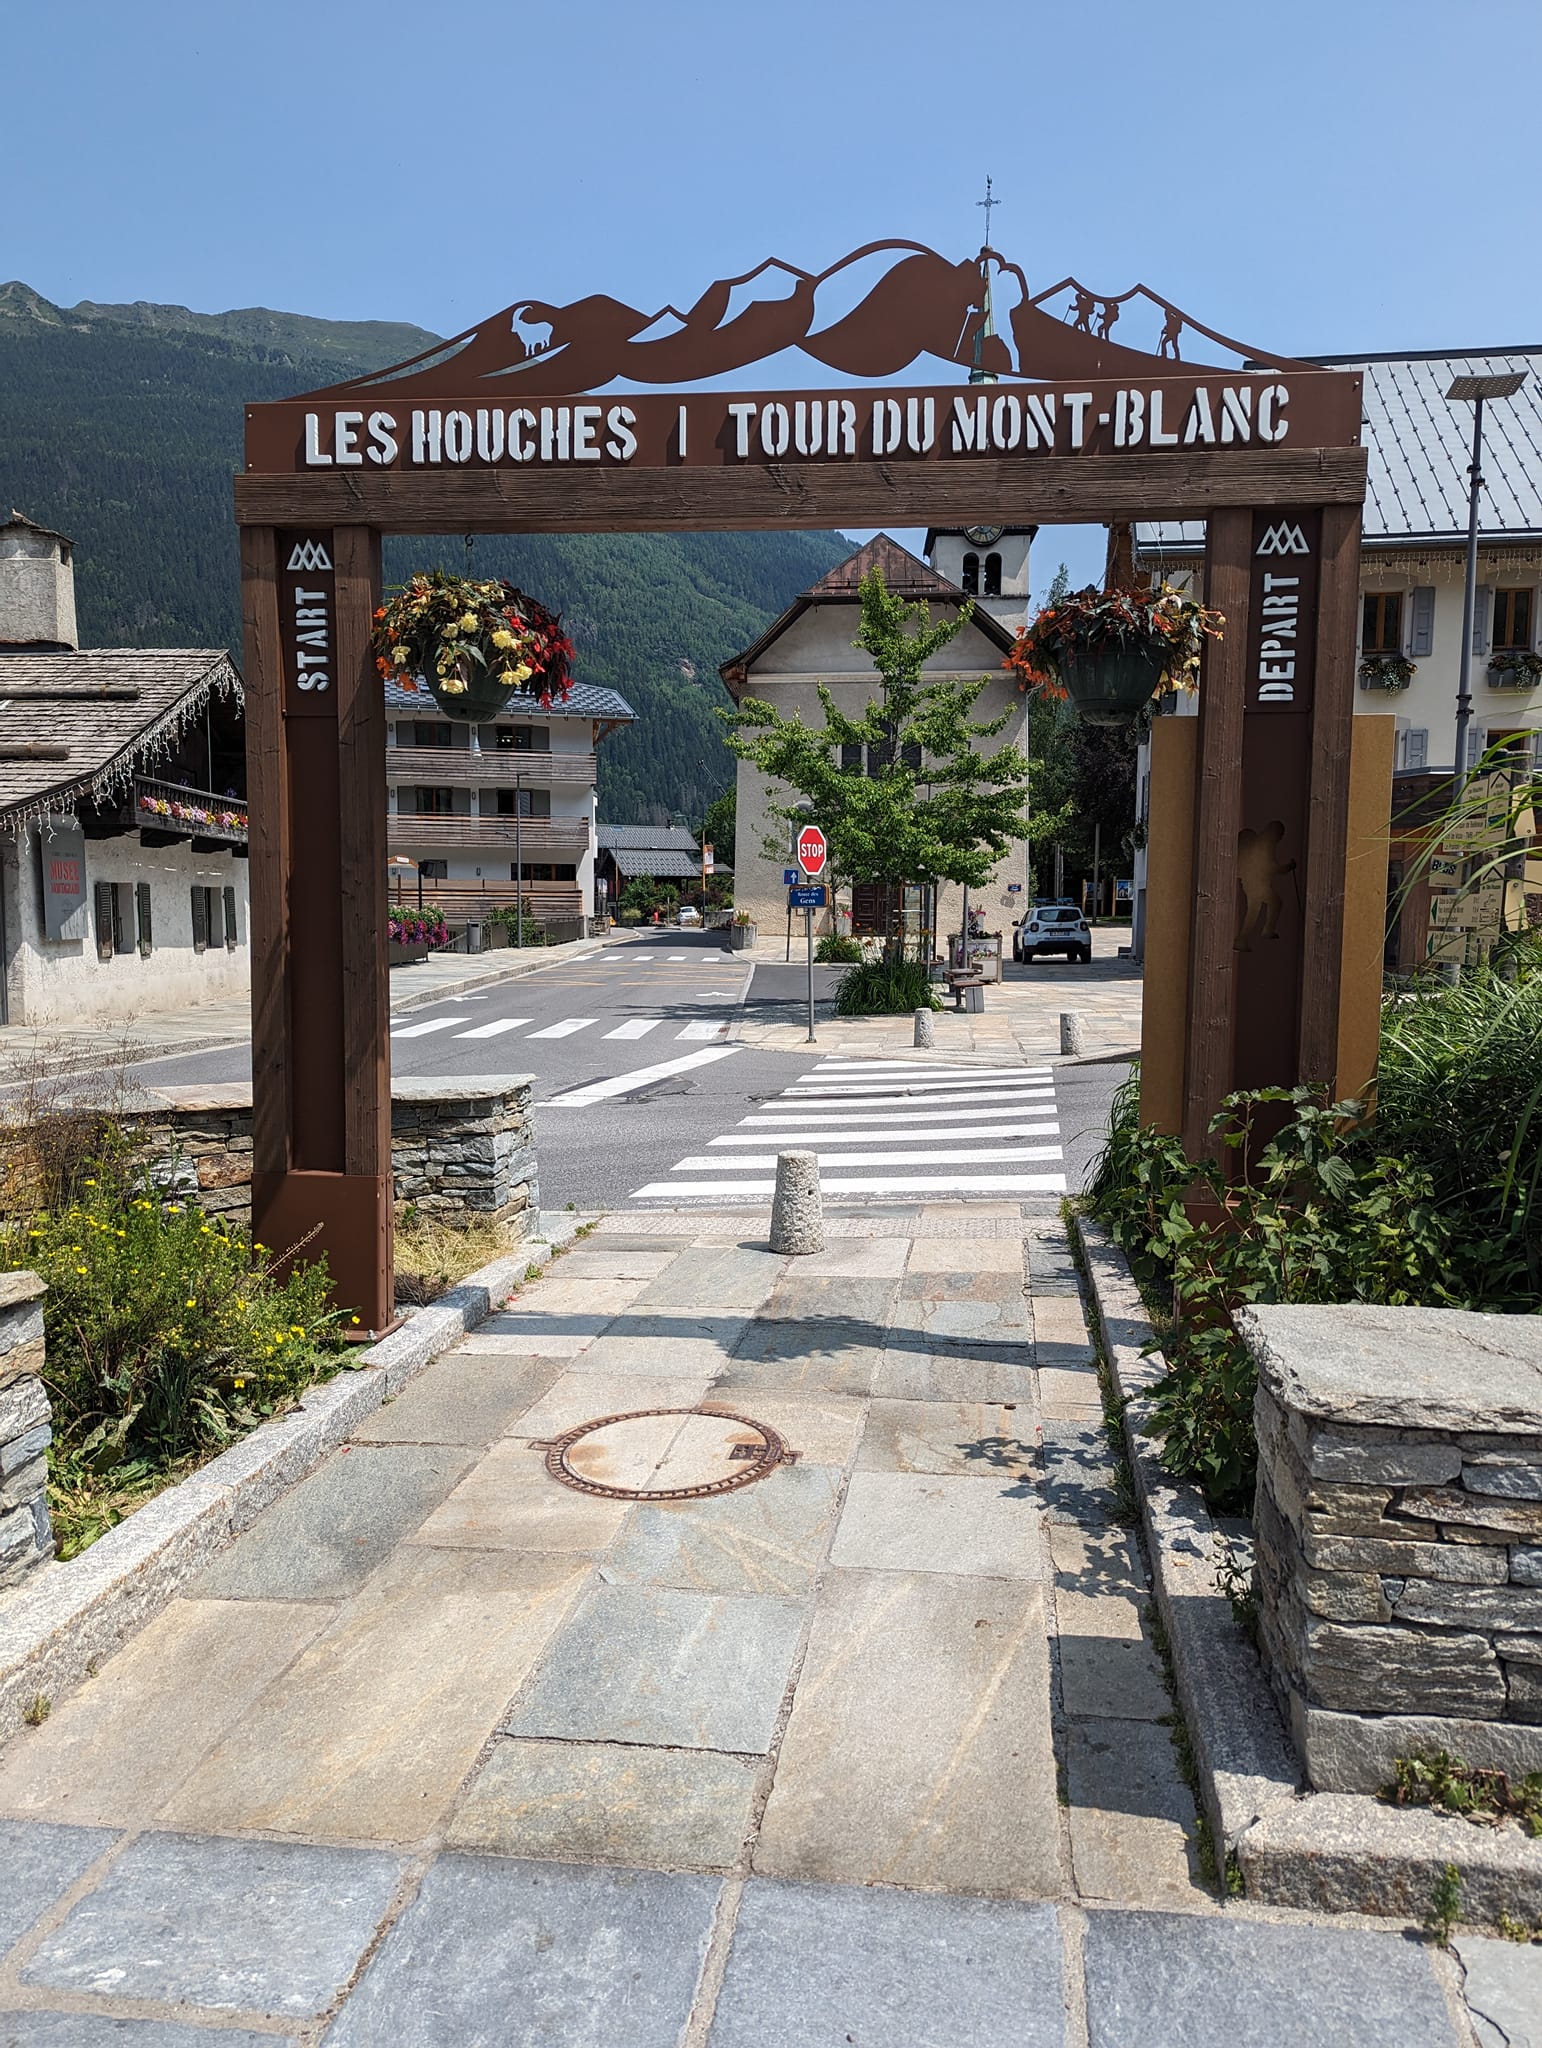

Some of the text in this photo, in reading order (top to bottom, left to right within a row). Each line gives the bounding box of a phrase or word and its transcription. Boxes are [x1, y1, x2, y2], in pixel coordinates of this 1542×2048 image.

[306, 411, 398, 465] LES
[411, 405, 637, 463] HOUCHES
[728, 399, 857, 458] TOUR
[872, 397, 935, 455] DU
[951, 385, 1290, 453] MONT-BLANC
[295, 587, 330, 691] START
[1258, 572, 1299, 701] DEPART
[801, 843, 823, 858] STOP
